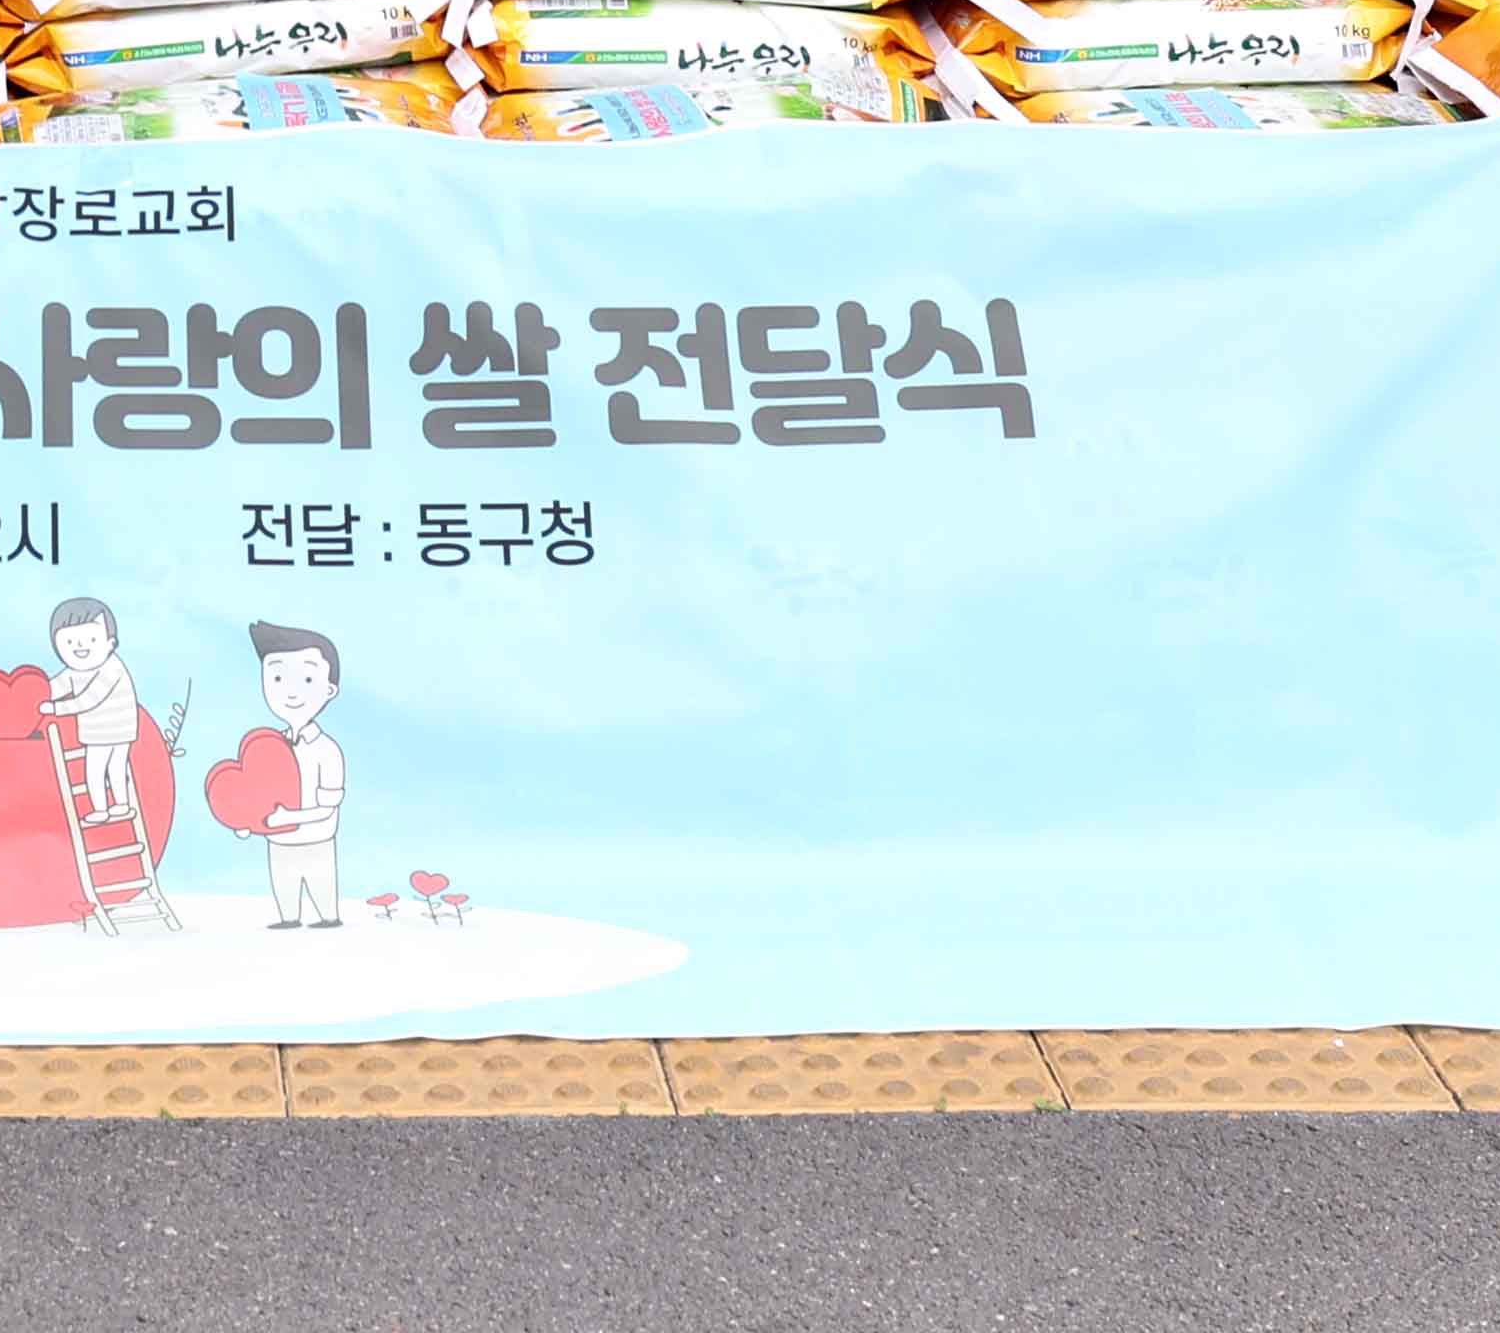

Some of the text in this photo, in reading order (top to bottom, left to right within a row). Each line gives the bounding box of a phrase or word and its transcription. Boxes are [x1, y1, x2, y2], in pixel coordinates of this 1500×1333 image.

[409, 301, 560, 448] 쌀
[589, 297, 1036, 446] 전달식
[241, 500, 595, 567] 전달 동구청
